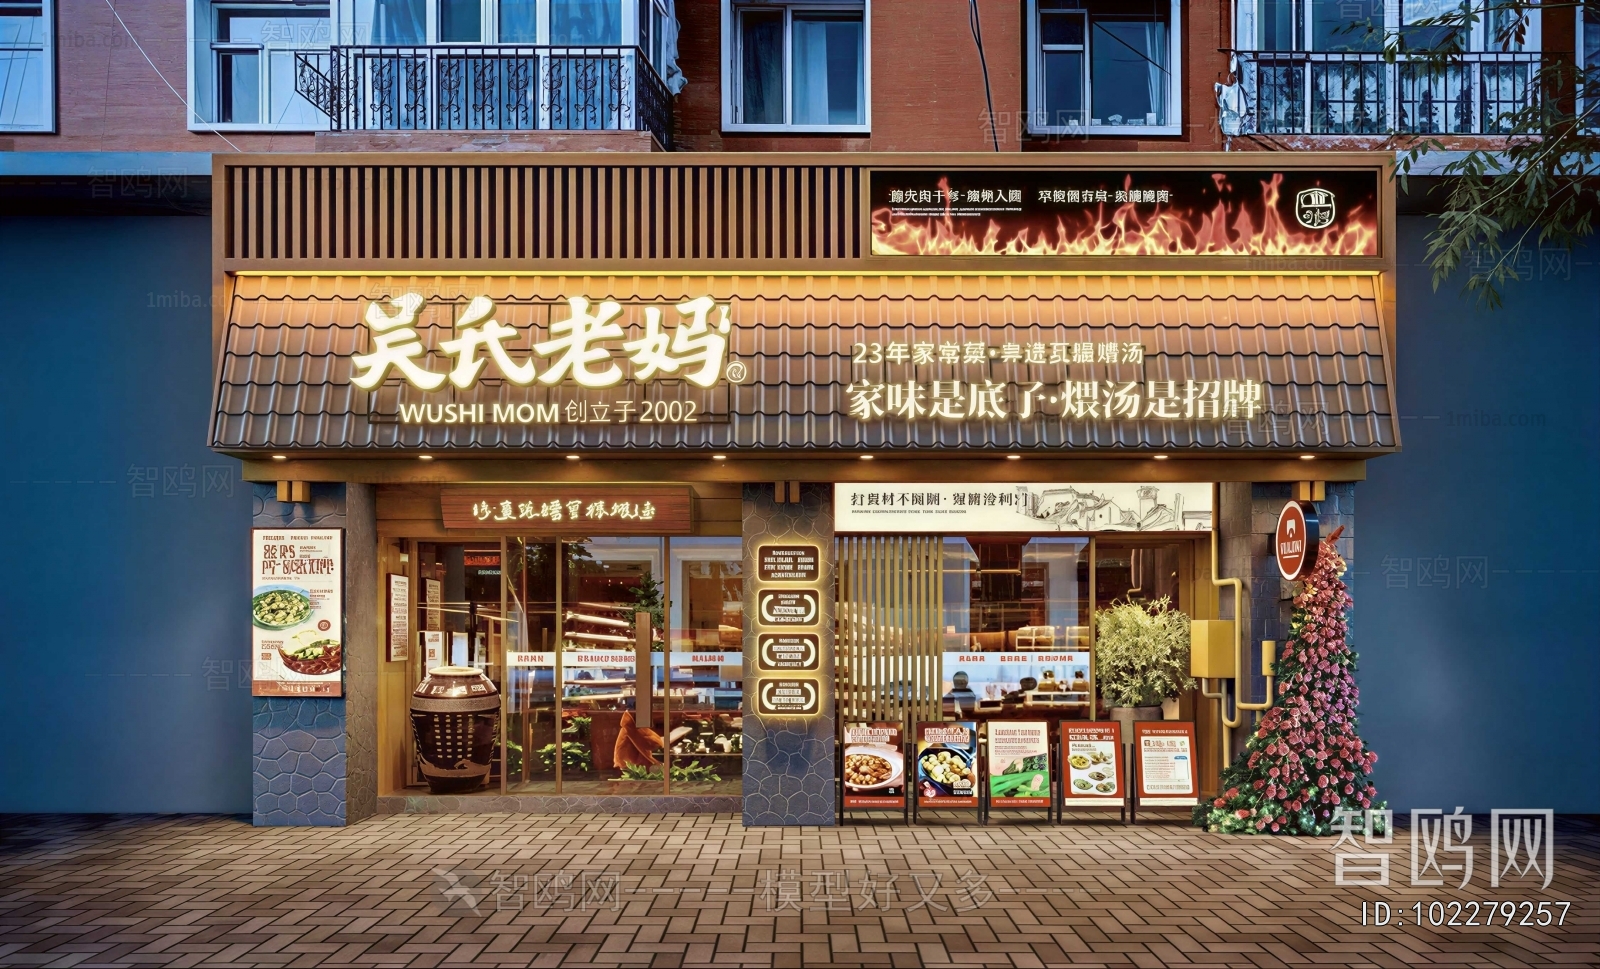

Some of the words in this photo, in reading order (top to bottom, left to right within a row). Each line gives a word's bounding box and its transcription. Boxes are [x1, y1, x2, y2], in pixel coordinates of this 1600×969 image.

[350, 294, 728, 391] 吴氏老妈
[399, 403, 484, 423] WUSHI
[493, 403, 559, 423] MOM
